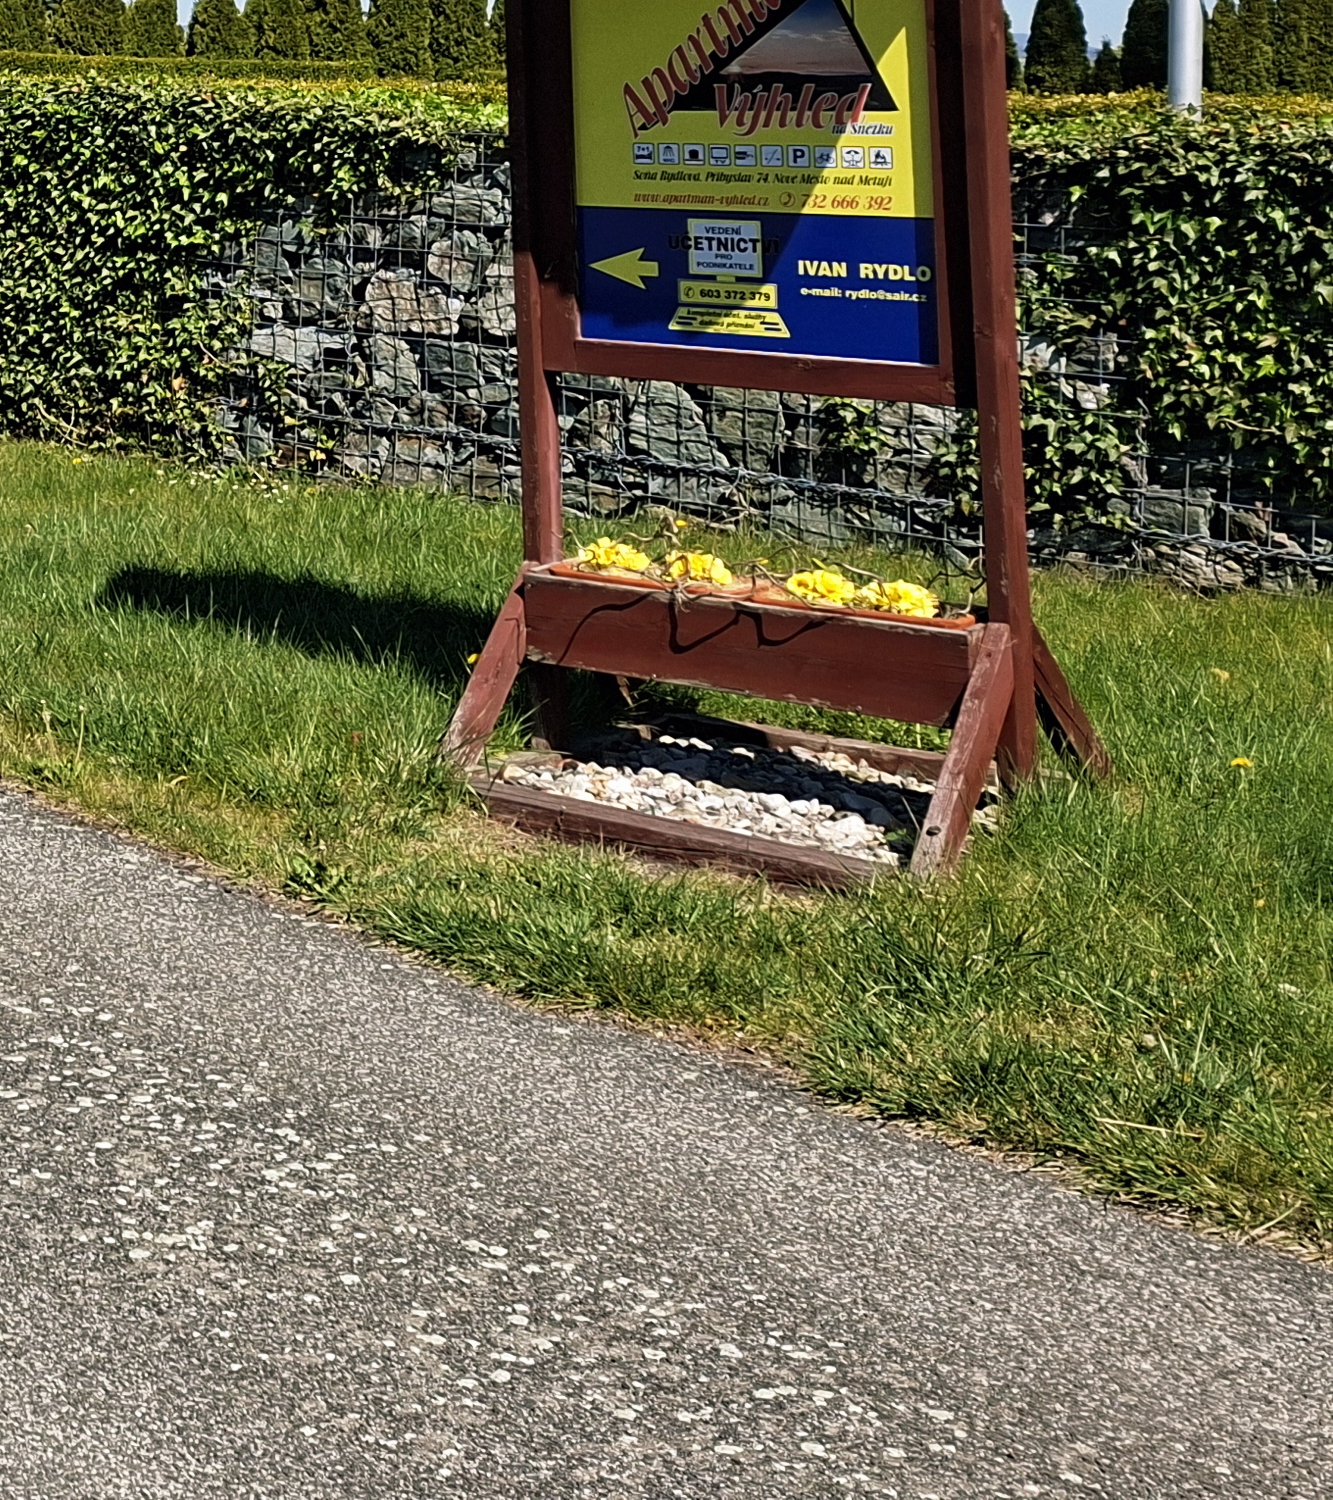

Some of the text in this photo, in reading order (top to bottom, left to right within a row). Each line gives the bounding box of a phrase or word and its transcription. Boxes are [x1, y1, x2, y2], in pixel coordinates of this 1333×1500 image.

[713, 83, 873, 137] Výhled
[831, 124, 847, 135] na
[792, 148, 805, 164] P
[833, 174, 855, 186] nad
[801, 193, 827, 209] 732
[831, 194, 861, 210] 666
[863, 195, 893, 211] 392
[704, 225, 742, 236] VEDENÍ
[696, 261, 755, 270] PODNIKATELE
[798, 260, 932, 282] IVAN RYDLO
[699, 288, 771, 302] 603 372 379
[800, 287, 842, 297] e-mail:
